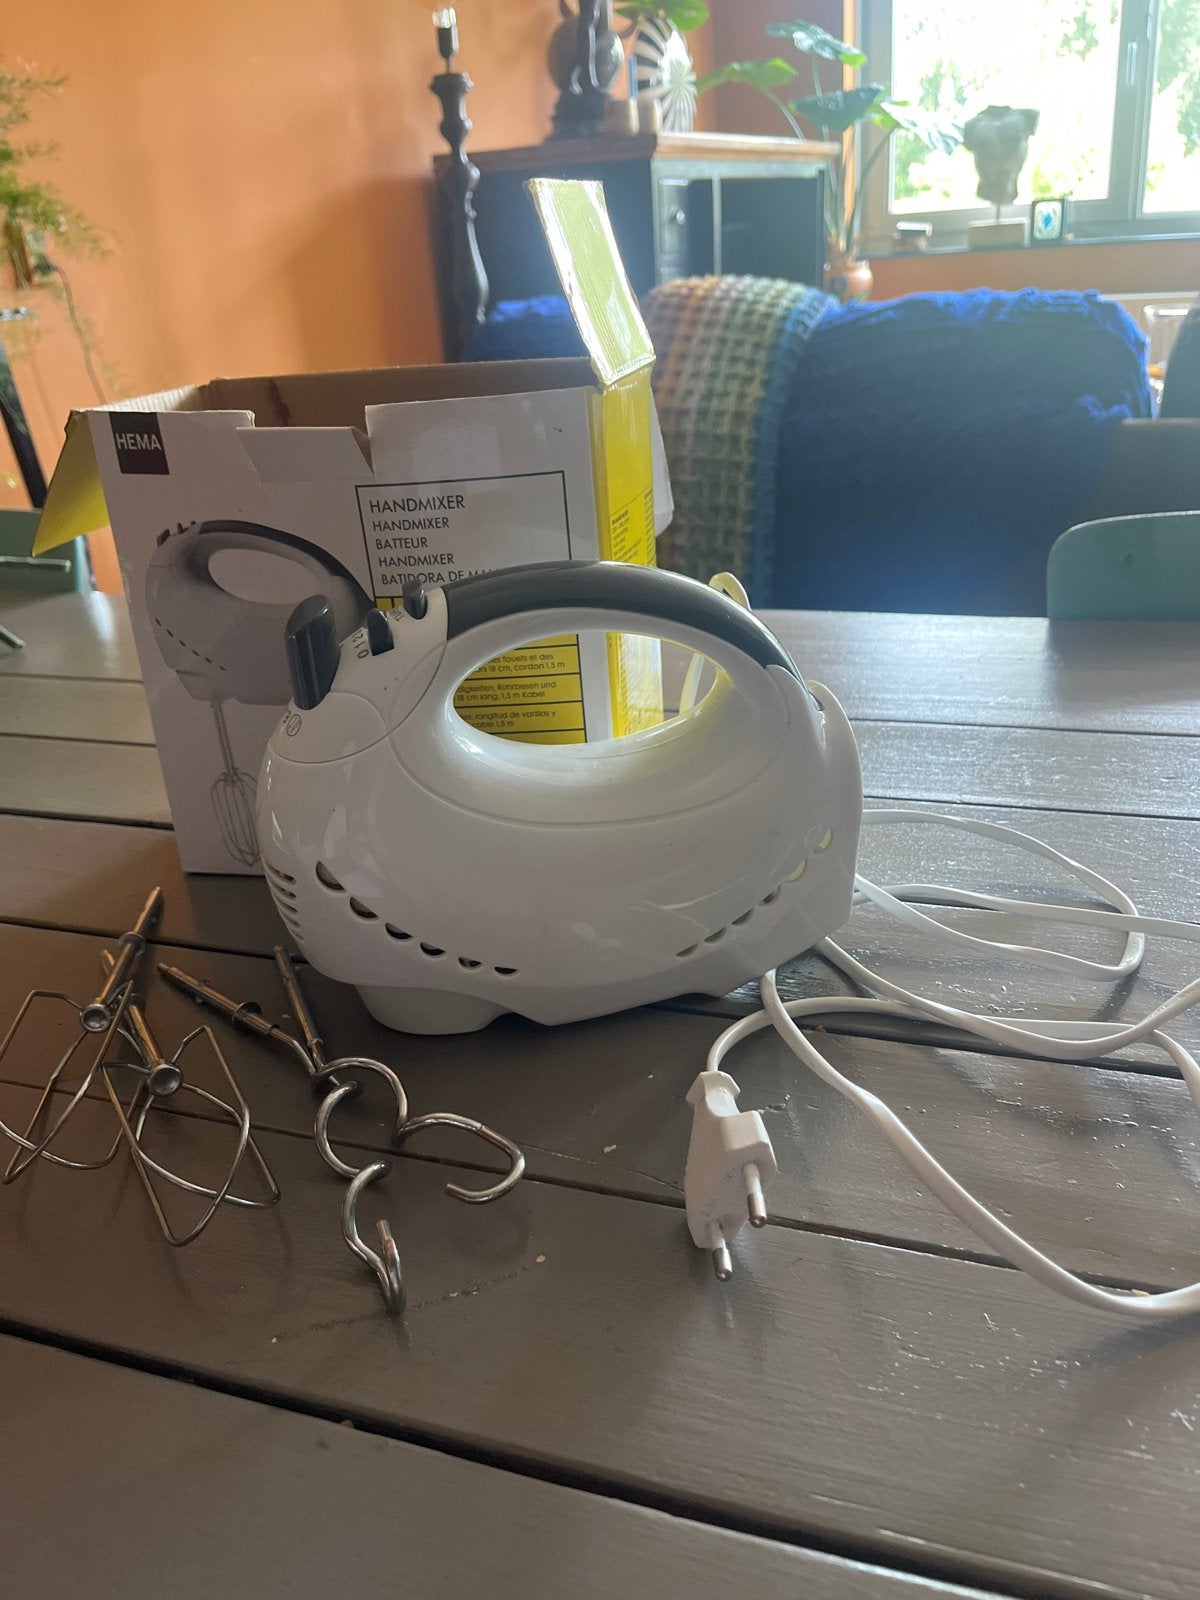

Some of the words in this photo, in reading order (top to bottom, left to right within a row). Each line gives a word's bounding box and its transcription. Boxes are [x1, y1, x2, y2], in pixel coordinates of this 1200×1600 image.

[115, 433, 162, 450] HEMA
[369, 494, 466, 514] HANDMIXER
[372, 517, 450, 532] HANDMIXER
[375, 536, 428, 550] BATTEUR
[378, 553, 455, 568] HANDMIXER
[448, 570, 464, 582] DE
[502, 653, 527, 662] fouets
[529, 653, 538, 661] et
[539, 653, 554, 661] des
[498, 665, 513, 673] cm,
[514, 662, 545, 671] cordon
[546, 661, 556, 669] 1,5
[556, 661, 565, 669] m
[541, 680, 557, 689] und
[512, 691, 521, 699] m
[522, 689, 546, 698] Kabel
[474, 711, 508, 720] longitud
[509, 710, 520, 719] de
[521, 709, 549, 718] varillas
[550, 710, 557, 718] y
[506, 720, 515, 728] m
